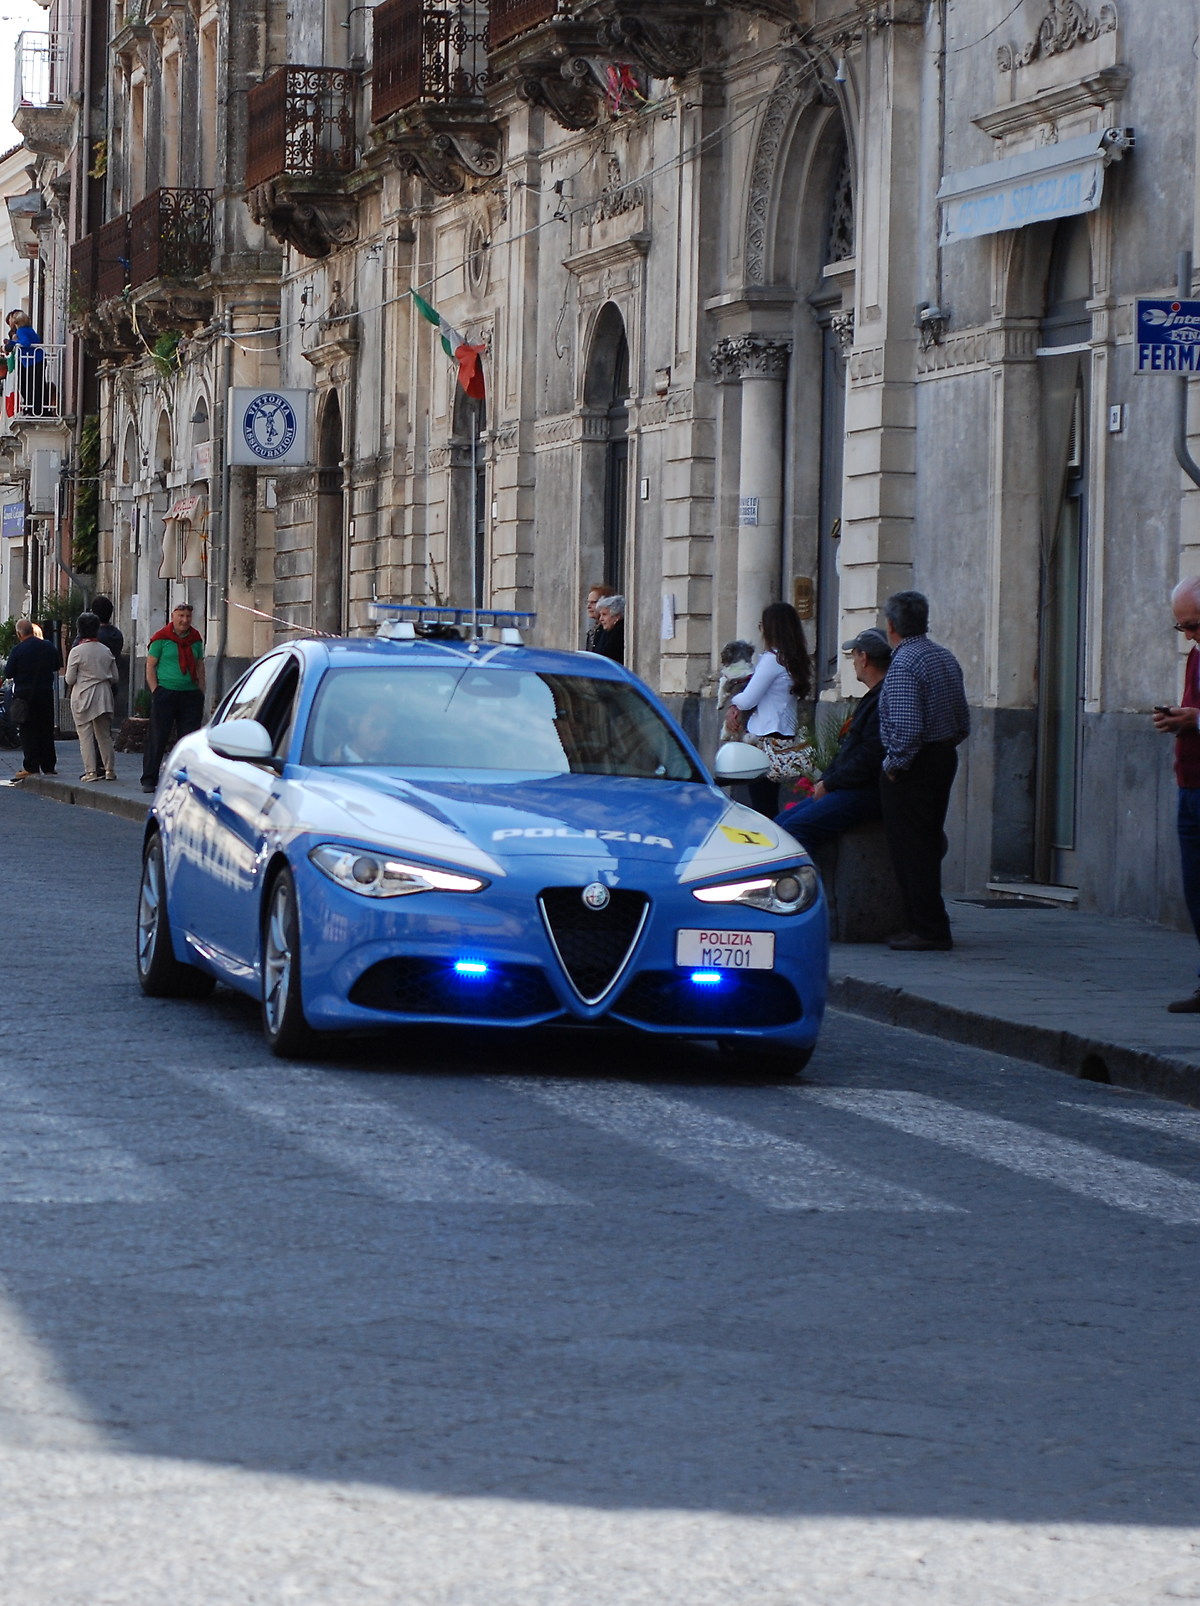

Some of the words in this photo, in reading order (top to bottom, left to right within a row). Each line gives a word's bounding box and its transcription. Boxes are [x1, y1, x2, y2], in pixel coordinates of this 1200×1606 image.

[1171, 329, 1200, 341] ETN
[248, 396, 290, 415] VITTORIA
[246, 427, 294, 457] ASSICURAZIONI
[492, 827, 674, 850] POLIZIA
[699, 932, 753, 946] POLIZIA
[702, 948, 751, 967] M2701
